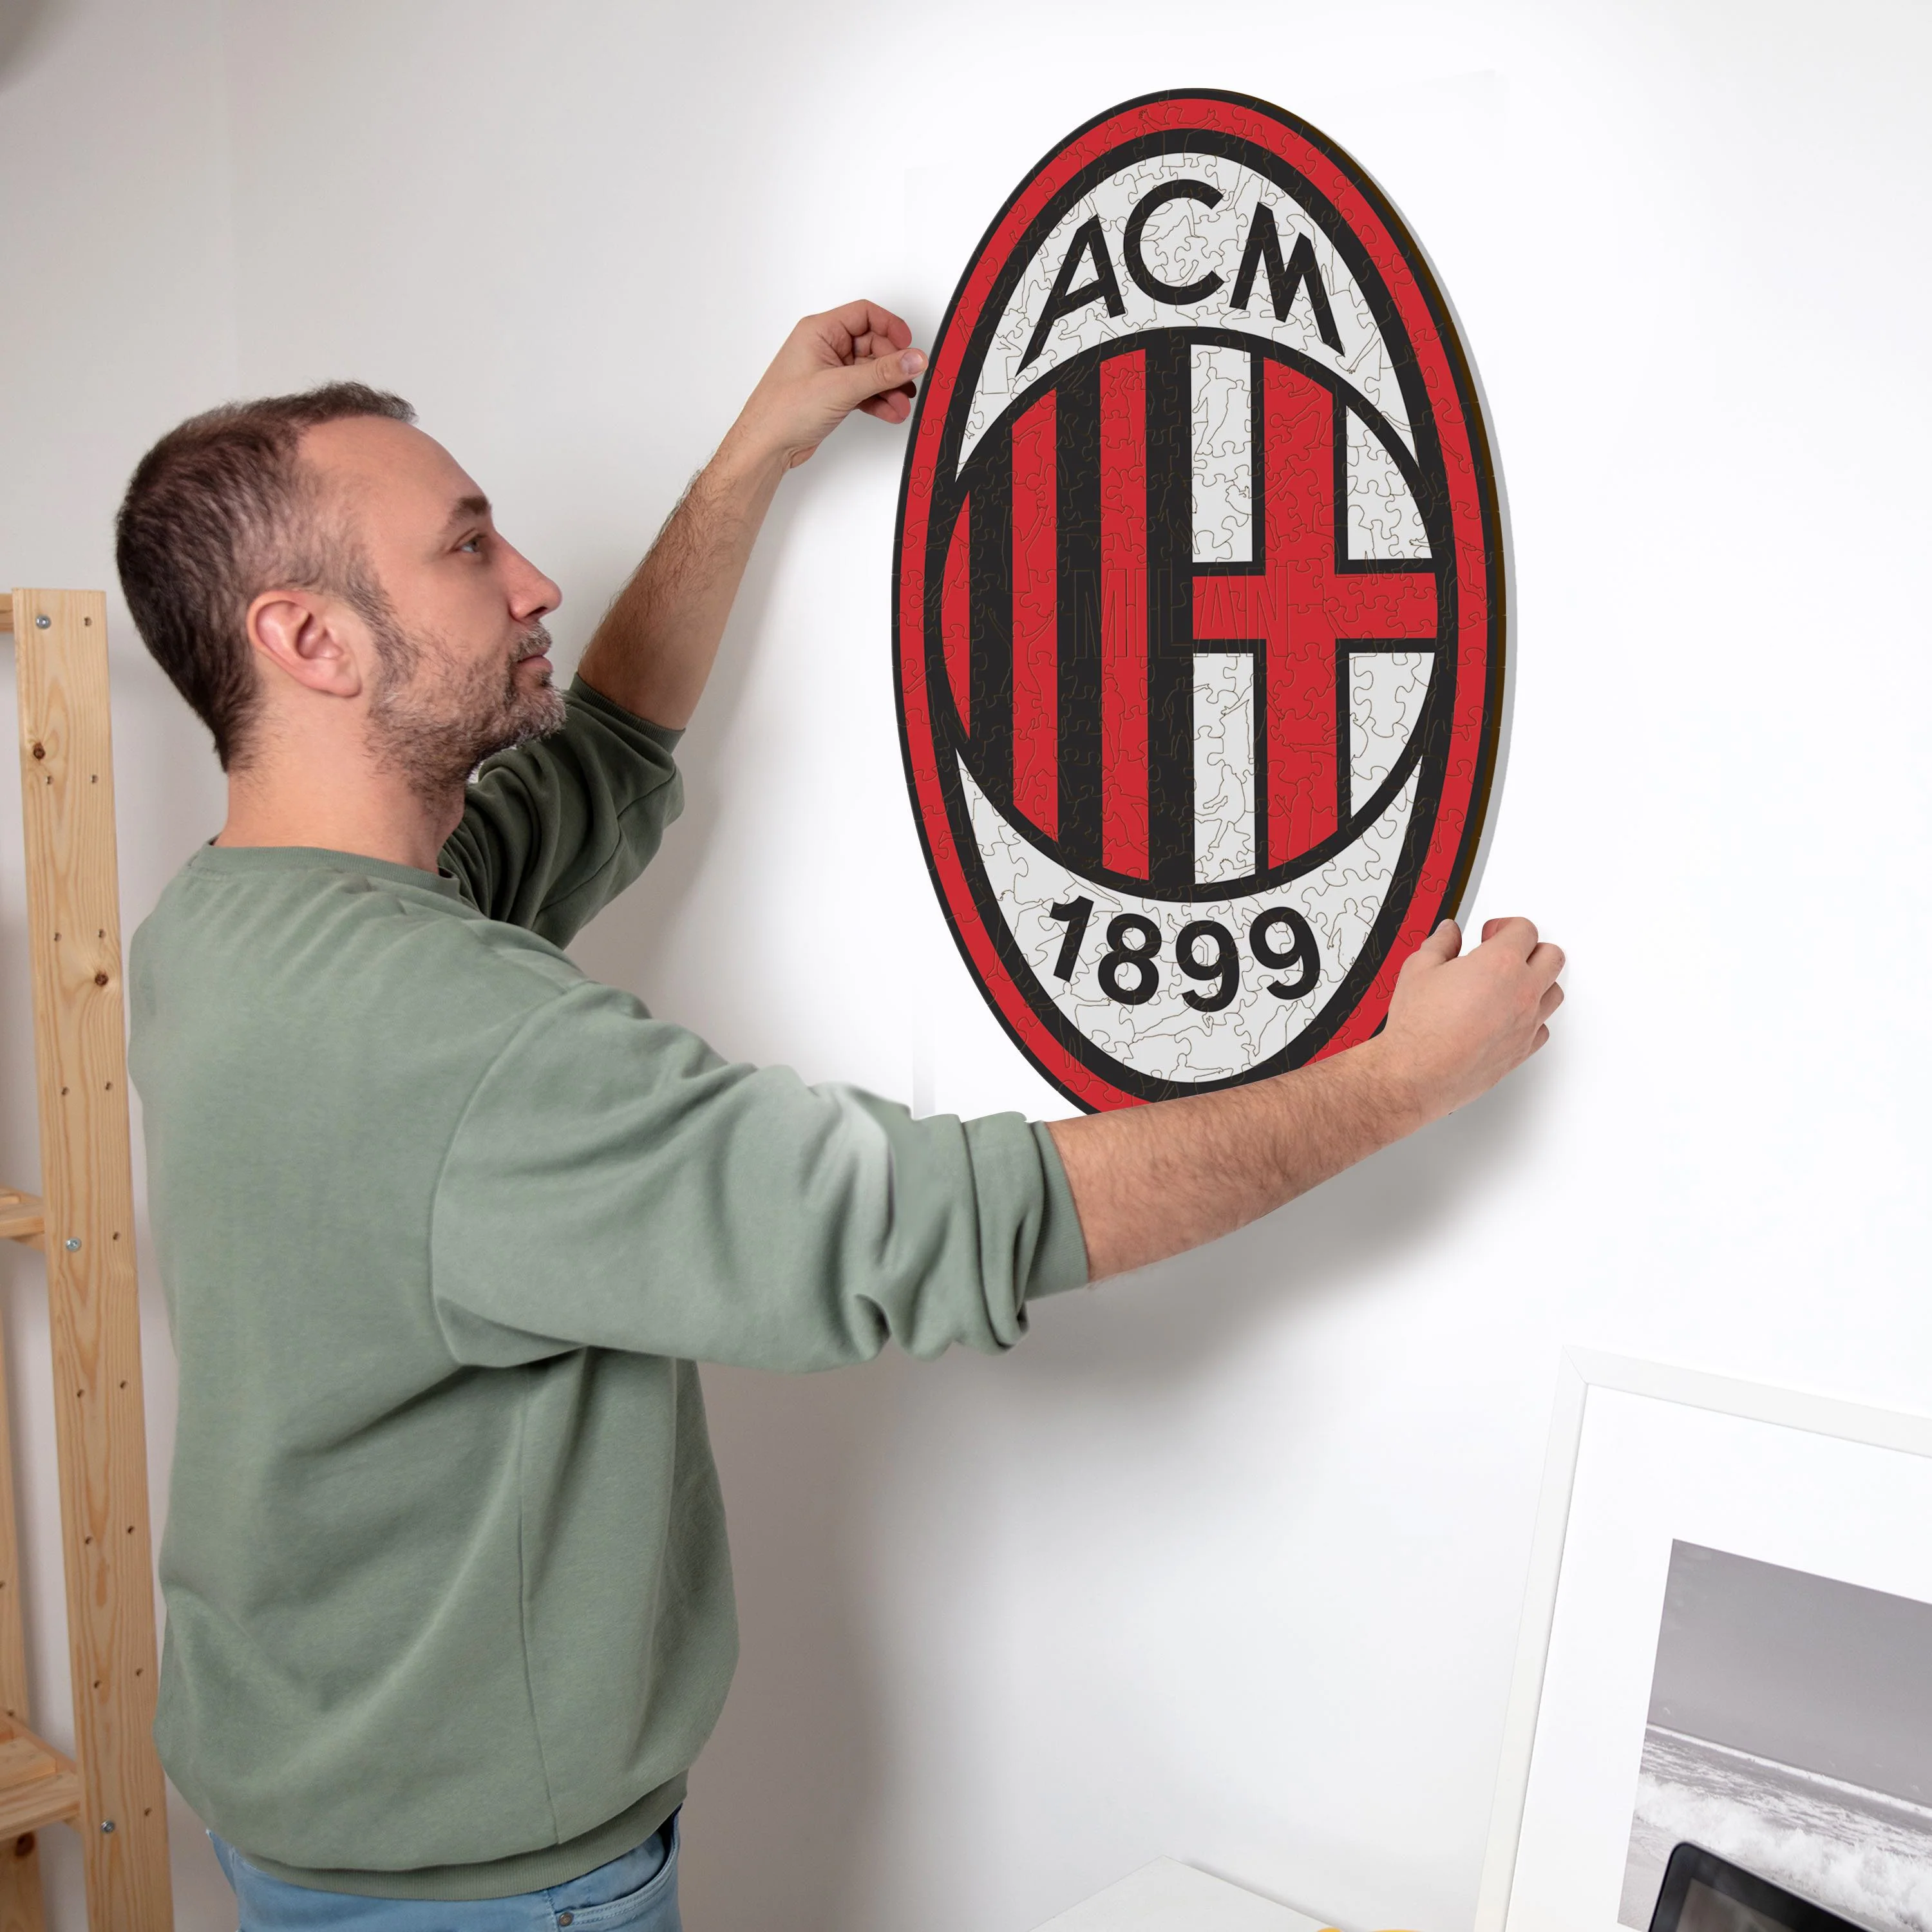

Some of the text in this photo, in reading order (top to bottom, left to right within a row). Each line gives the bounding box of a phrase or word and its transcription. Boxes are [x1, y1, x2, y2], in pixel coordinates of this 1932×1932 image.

[1015, 178, 1345, 377] ACM
[1075, 567, 1289, 658] MILAN
[1050, 895, 1321, 1012] 1899
